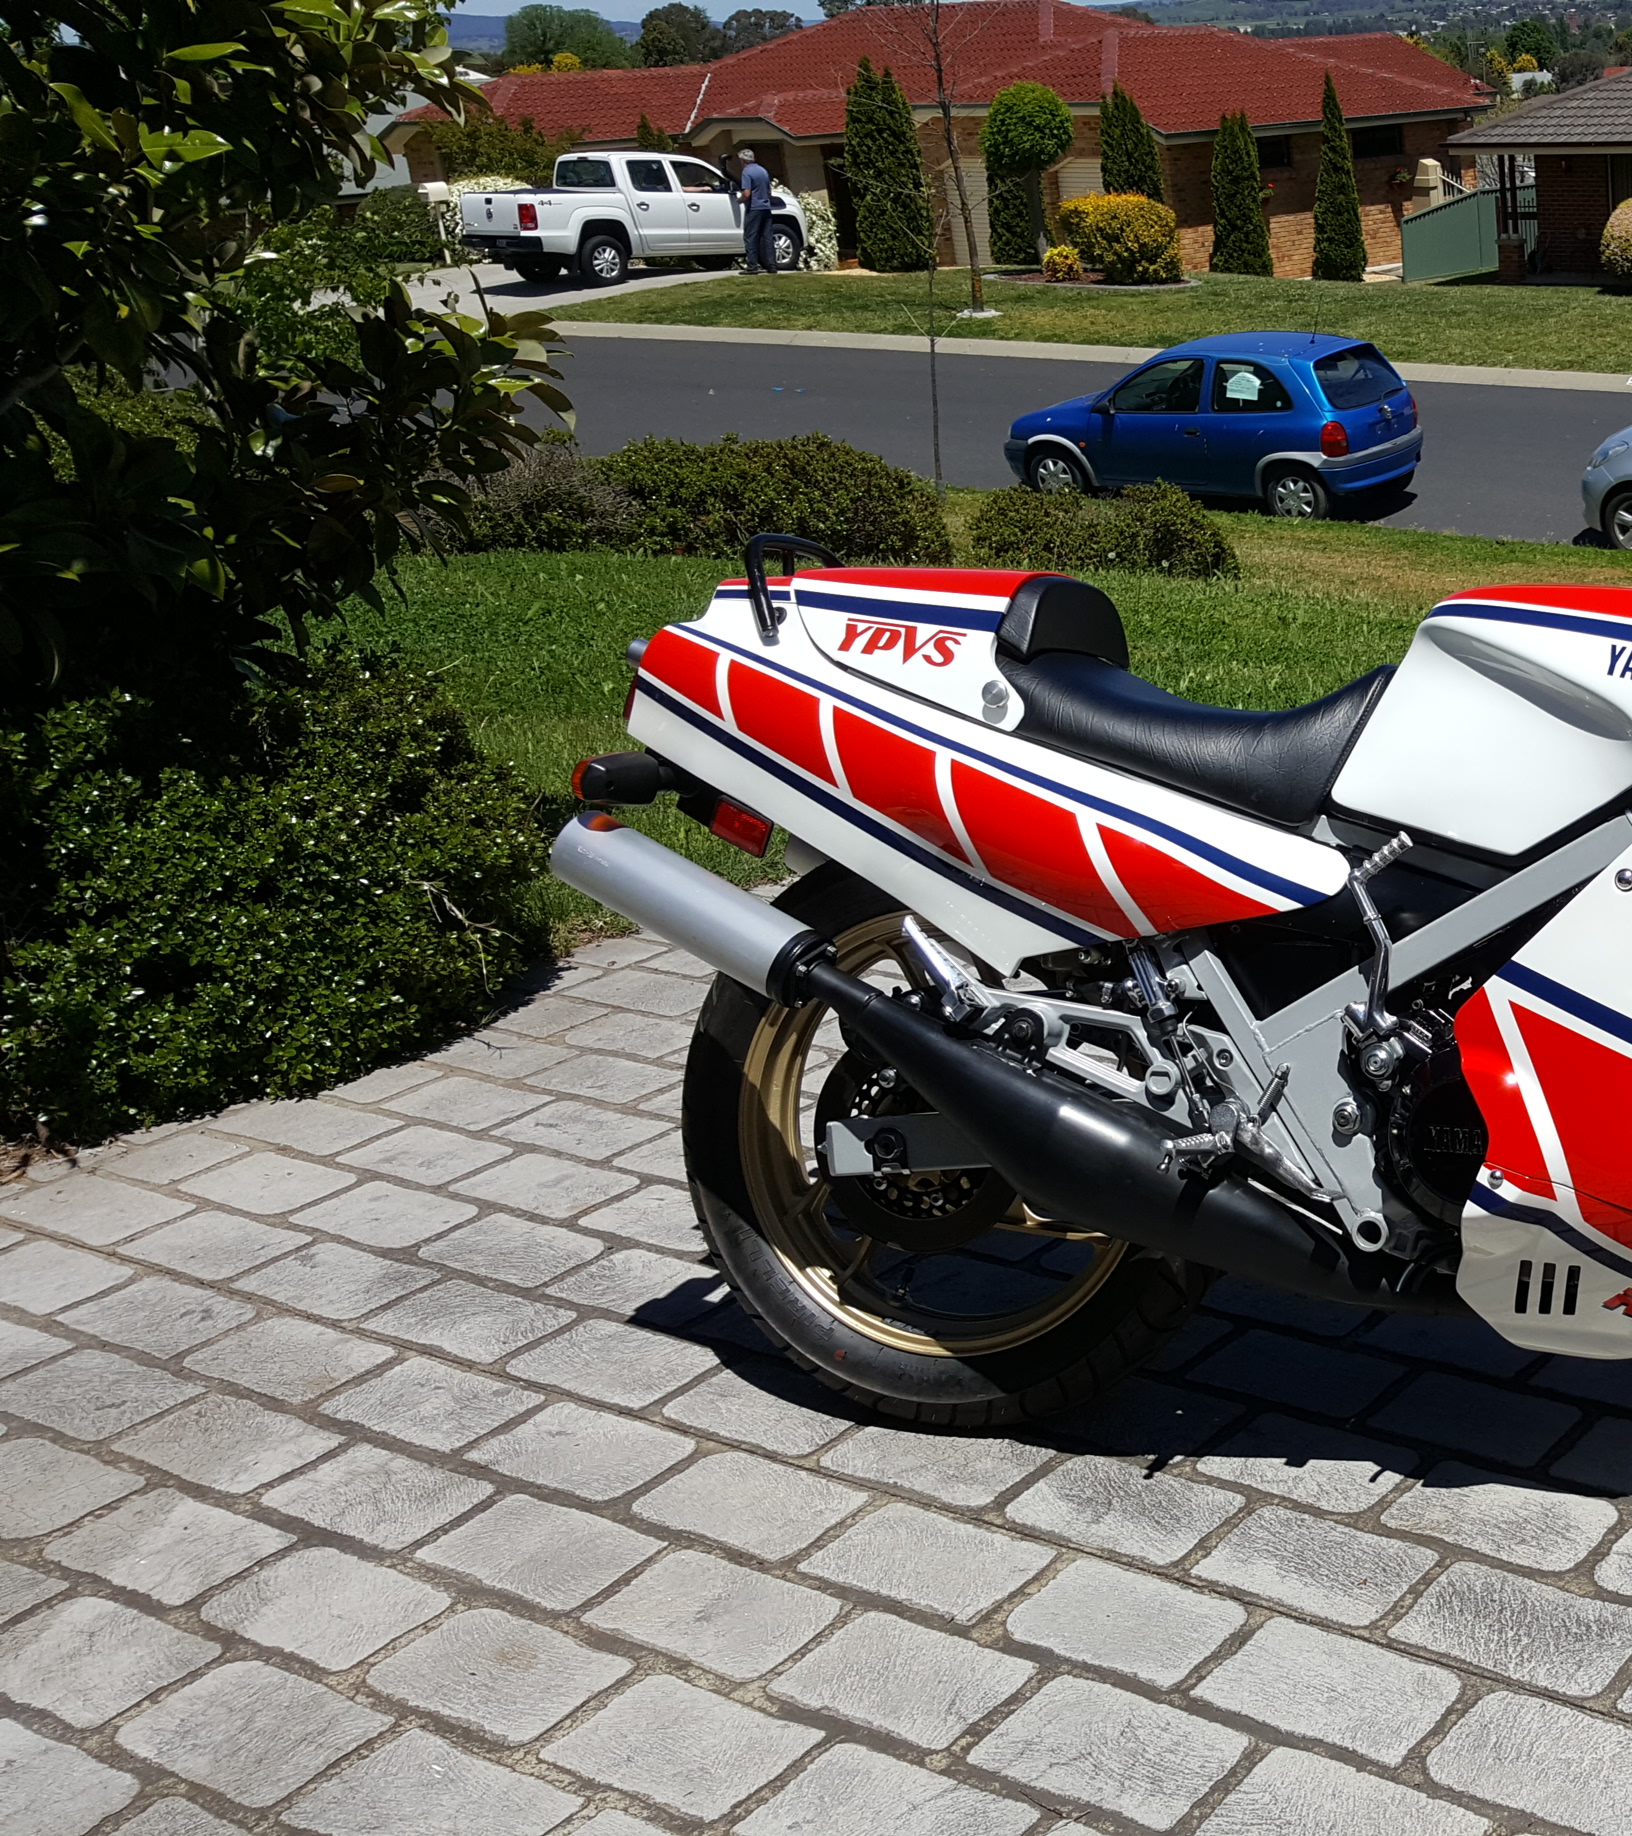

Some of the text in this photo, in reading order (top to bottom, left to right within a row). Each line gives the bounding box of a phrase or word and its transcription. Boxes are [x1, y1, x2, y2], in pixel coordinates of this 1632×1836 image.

[837, 617, 967, 667] YPVS
[1428, 1126, 1483, 1154] YAMA
[738, 1228, 836, 1341] PIRELLI
